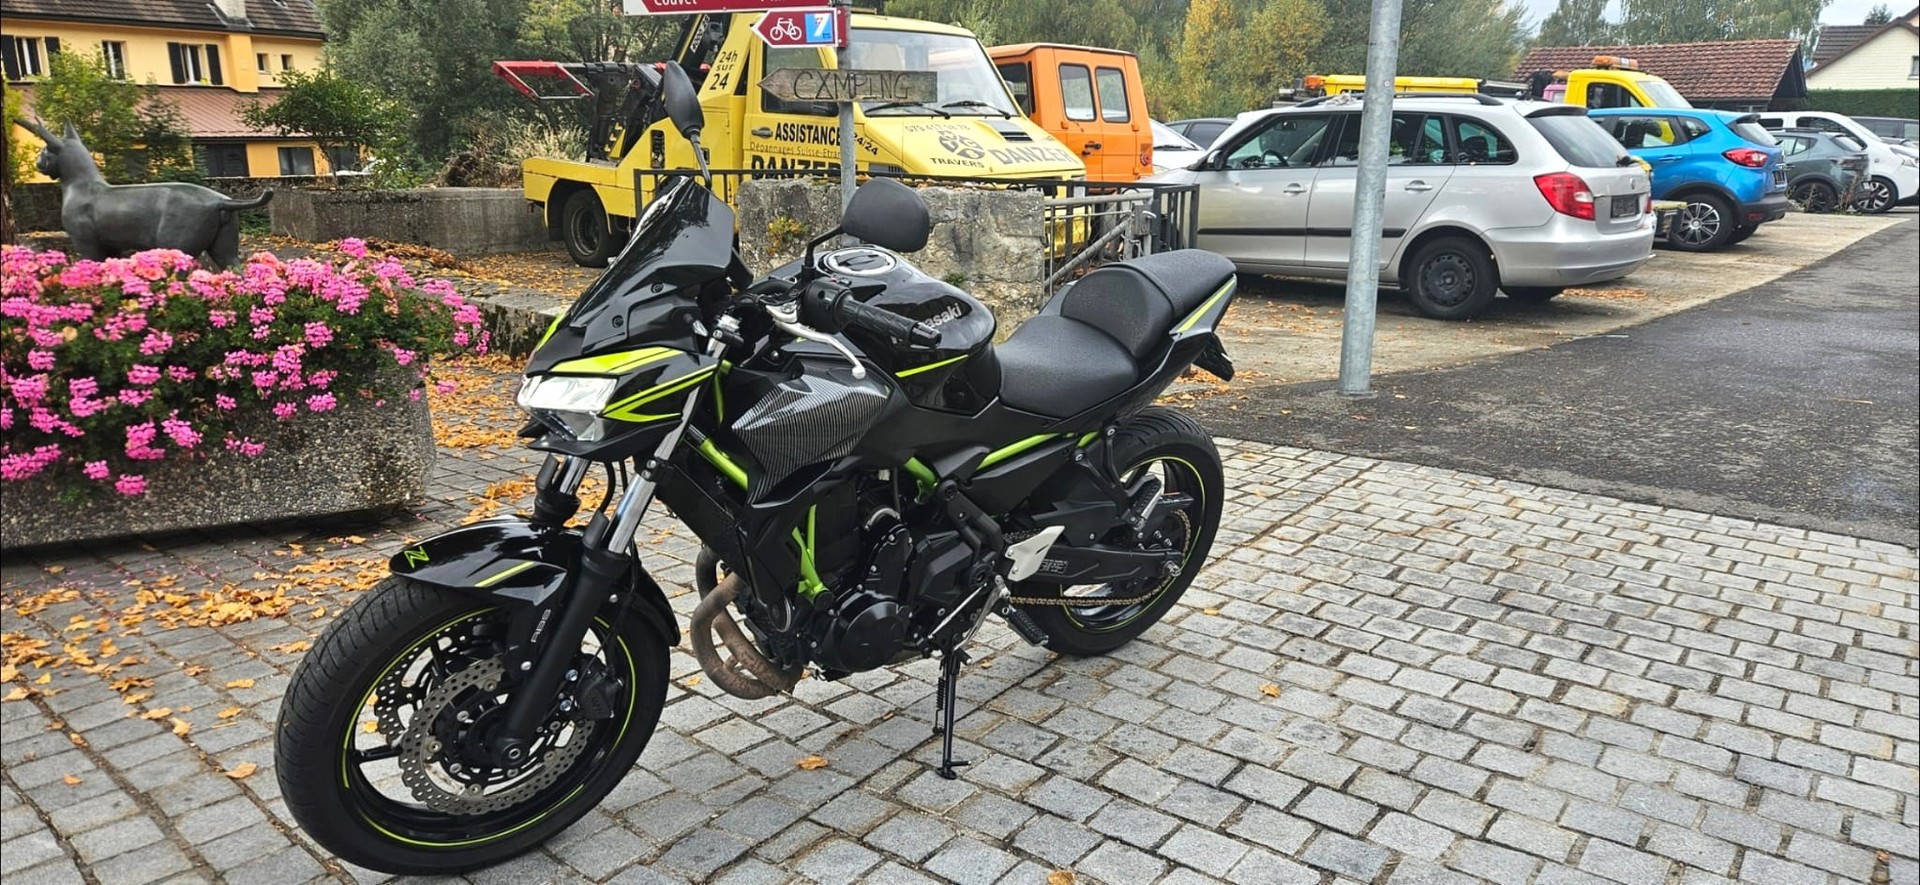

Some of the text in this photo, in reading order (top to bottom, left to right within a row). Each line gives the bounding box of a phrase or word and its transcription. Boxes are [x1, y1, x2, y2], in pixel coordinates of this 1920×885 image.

[814, 13, 832, 36] 7
[719, 50, 738, 63] 24h
[709, 73, 729, 90] 24
[930, 158, 984, 168] TRAVERS
[988, 147, 1079, 164] DANZER
[924, 302, 962, 327] asaki
[530, 609, 551, 642] ABS
